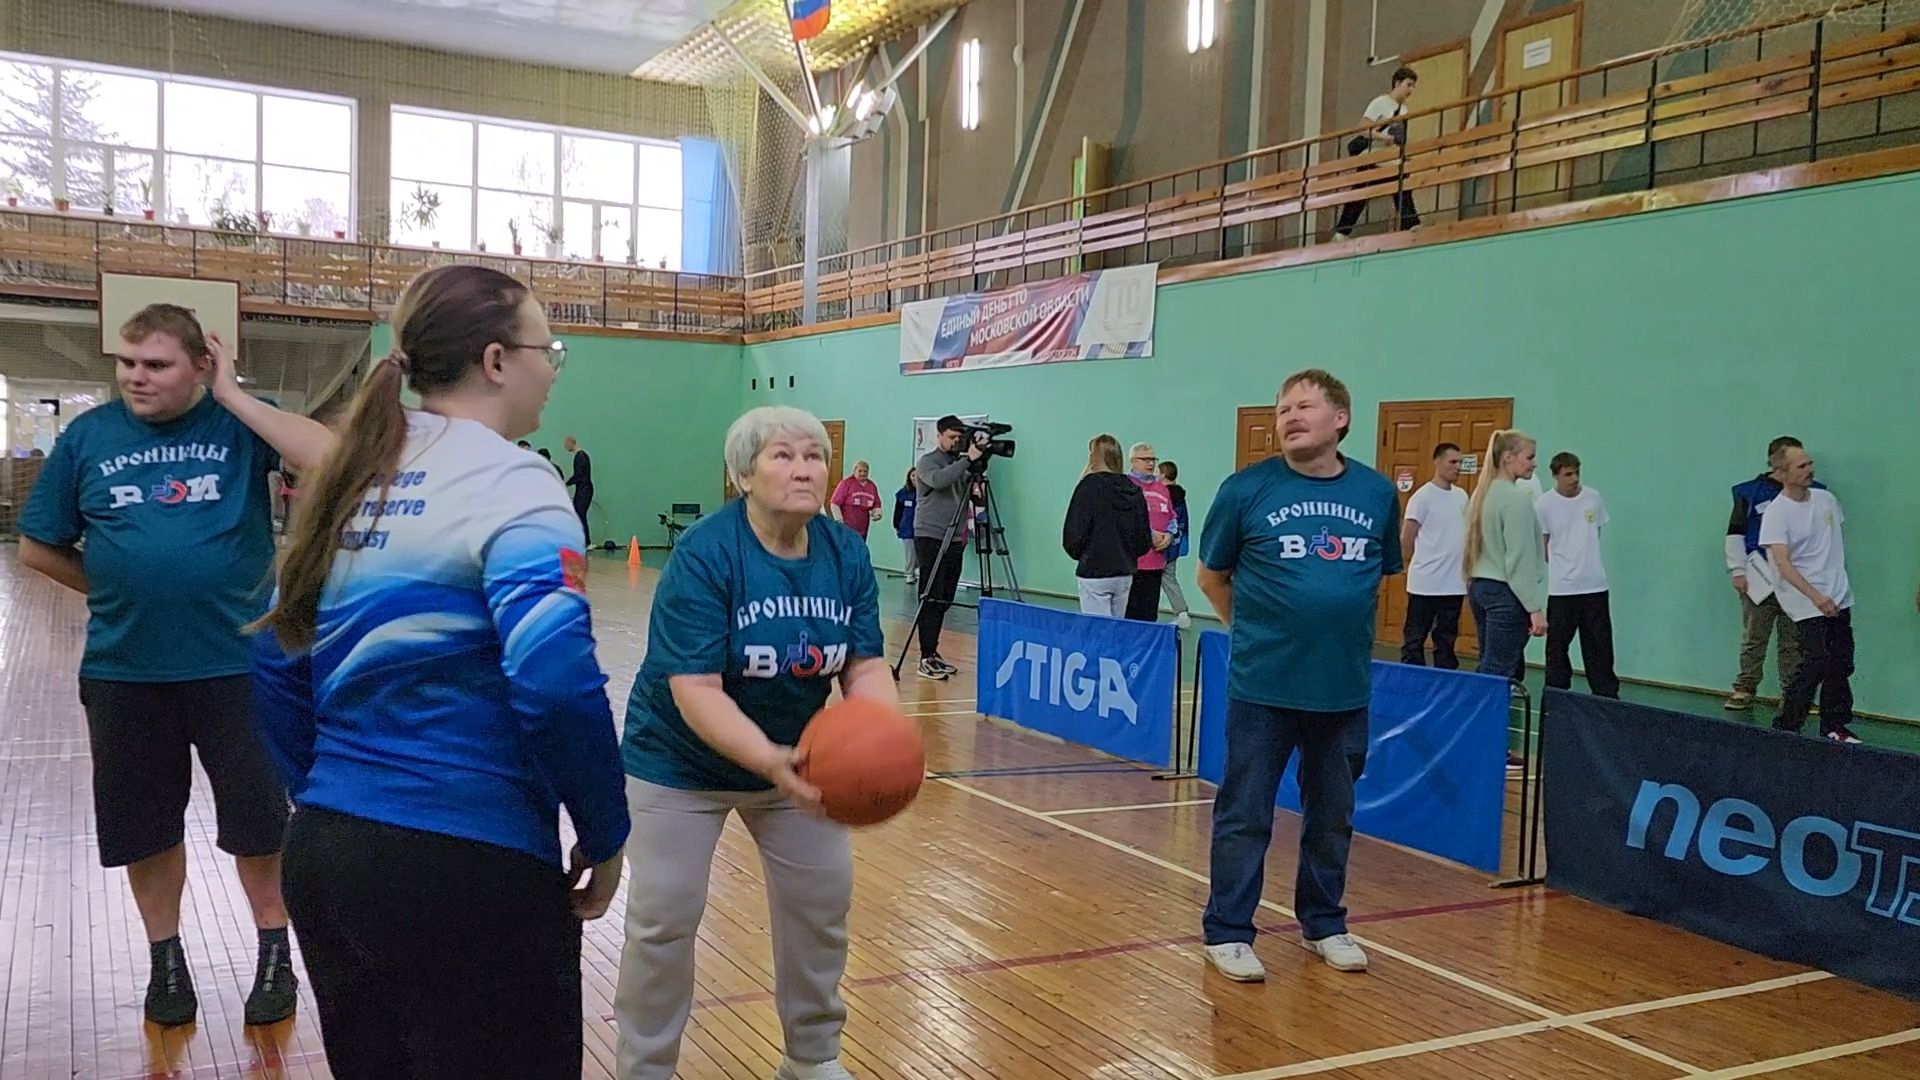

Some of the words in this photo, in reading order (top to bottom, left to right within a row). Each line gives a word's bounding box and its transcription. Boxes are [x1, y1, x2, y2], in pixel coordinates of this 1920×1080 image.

[941, 304, 980, 338] ЕДИНЫЙ
[981, 296, 1008, 321] ДЕНЬ
[970, 305, 1039, 347] МОСКОВСКОЙ
[1266, 501, 1374, 531] БРОННИЦЫ
